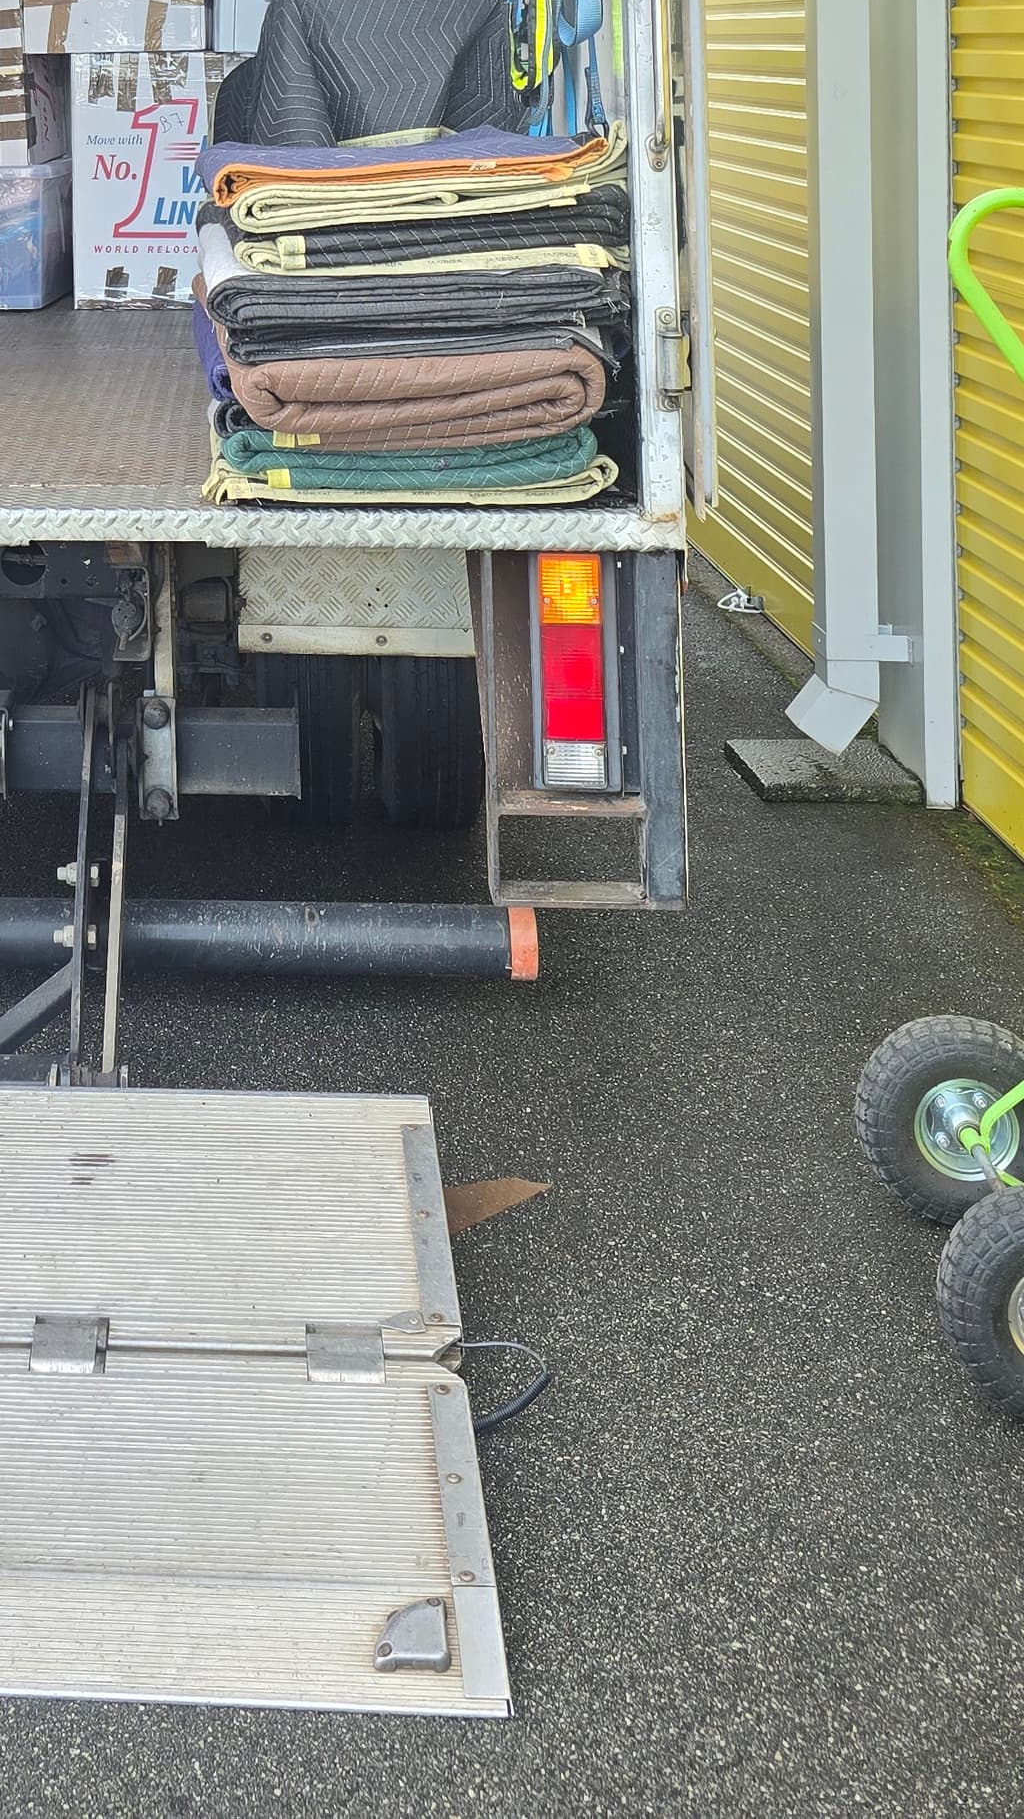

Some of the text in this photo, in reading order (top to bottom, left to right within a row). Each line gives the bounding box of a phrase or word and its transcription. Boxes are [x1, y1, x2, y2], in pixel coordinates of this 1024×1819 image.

[86, 134, 144, 146] Move with
[91, 154, 138, 181] No.
[94, 245, 199, 254] WORLD RELOCA
